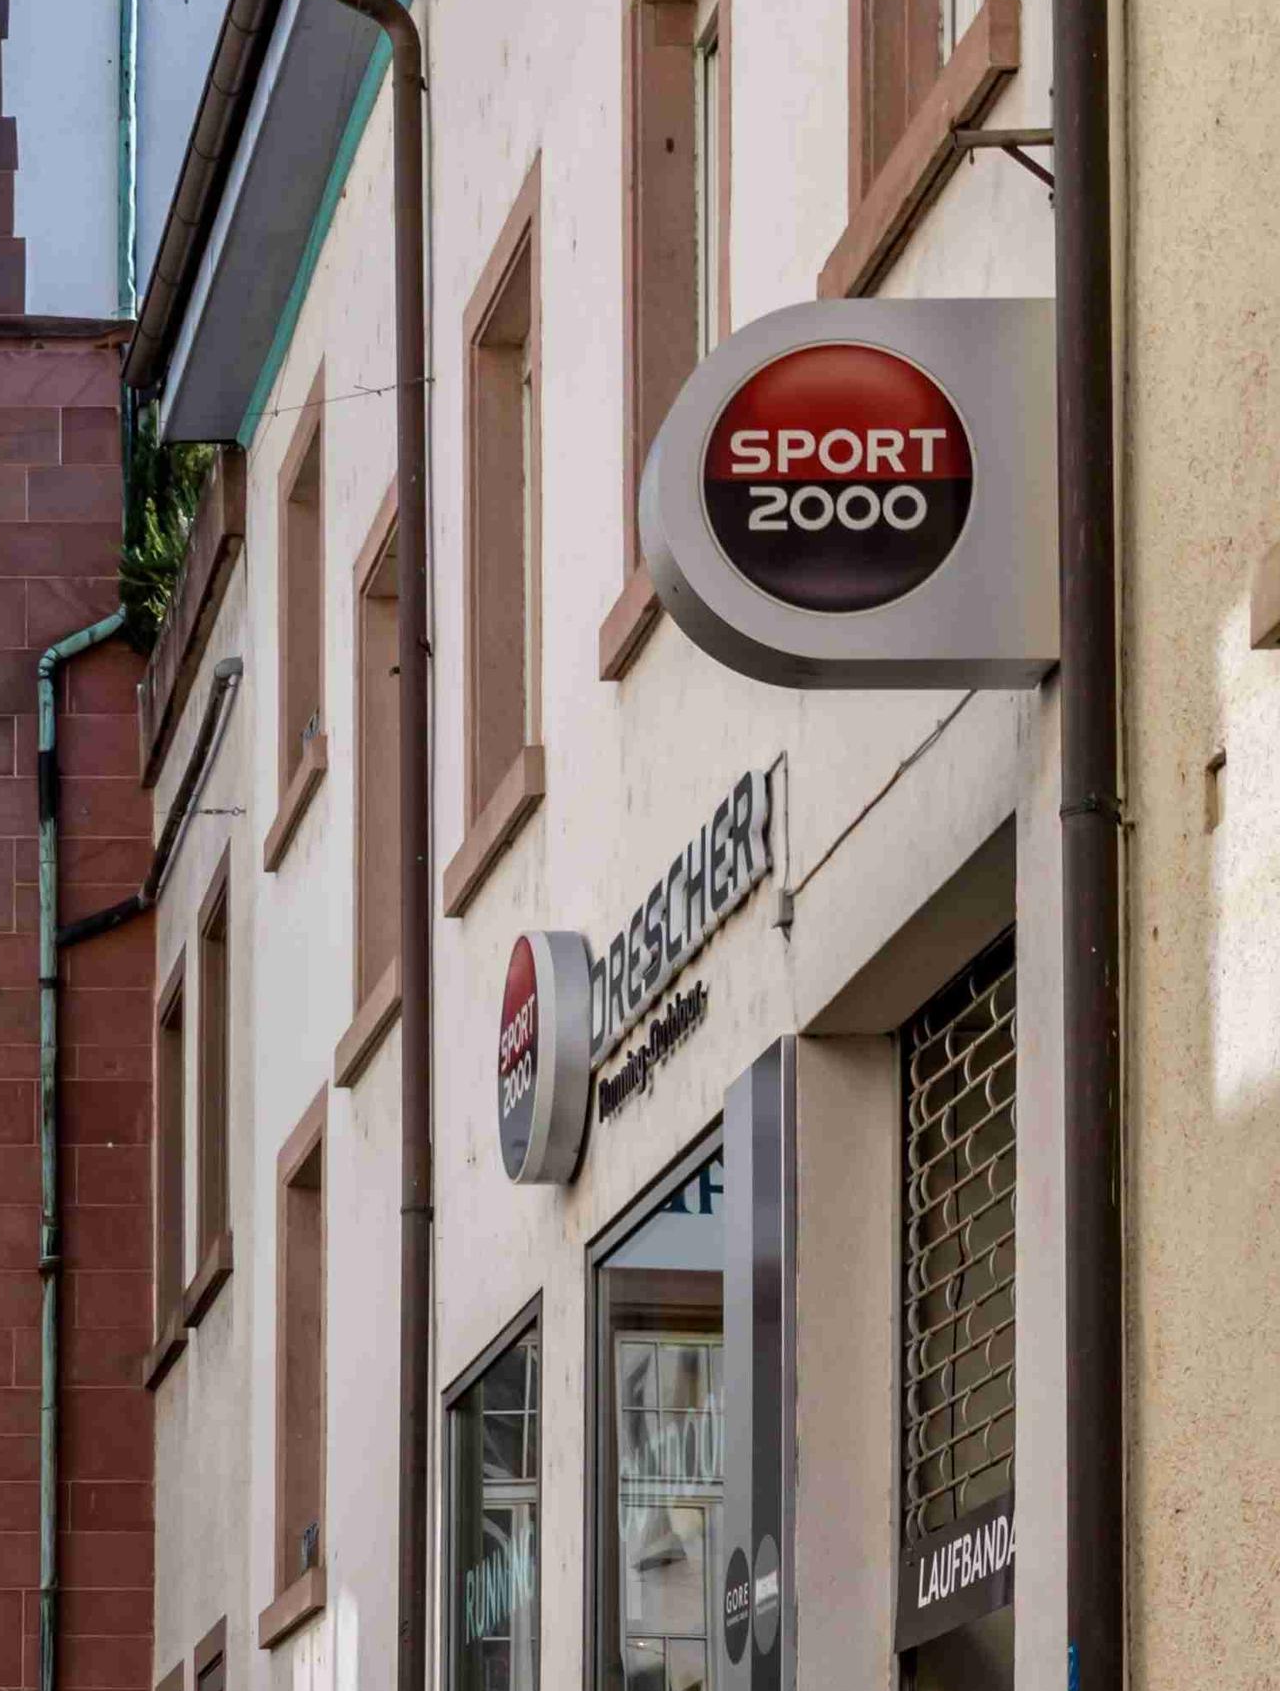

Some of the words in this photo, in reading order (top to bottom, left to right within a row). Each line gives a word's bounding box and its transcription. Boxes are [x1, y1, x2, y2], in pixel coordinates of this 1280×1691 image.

[730, 429, 946, 473] SPORT
[748, 485, 928, 531] 2000
[591, 770, 754, 1048] DRESCHER
[501, 993, 535, 1075] SPORT
[504, 1051, 533, 1119] 2000
[726, 1582, 748, 1614] GORE
